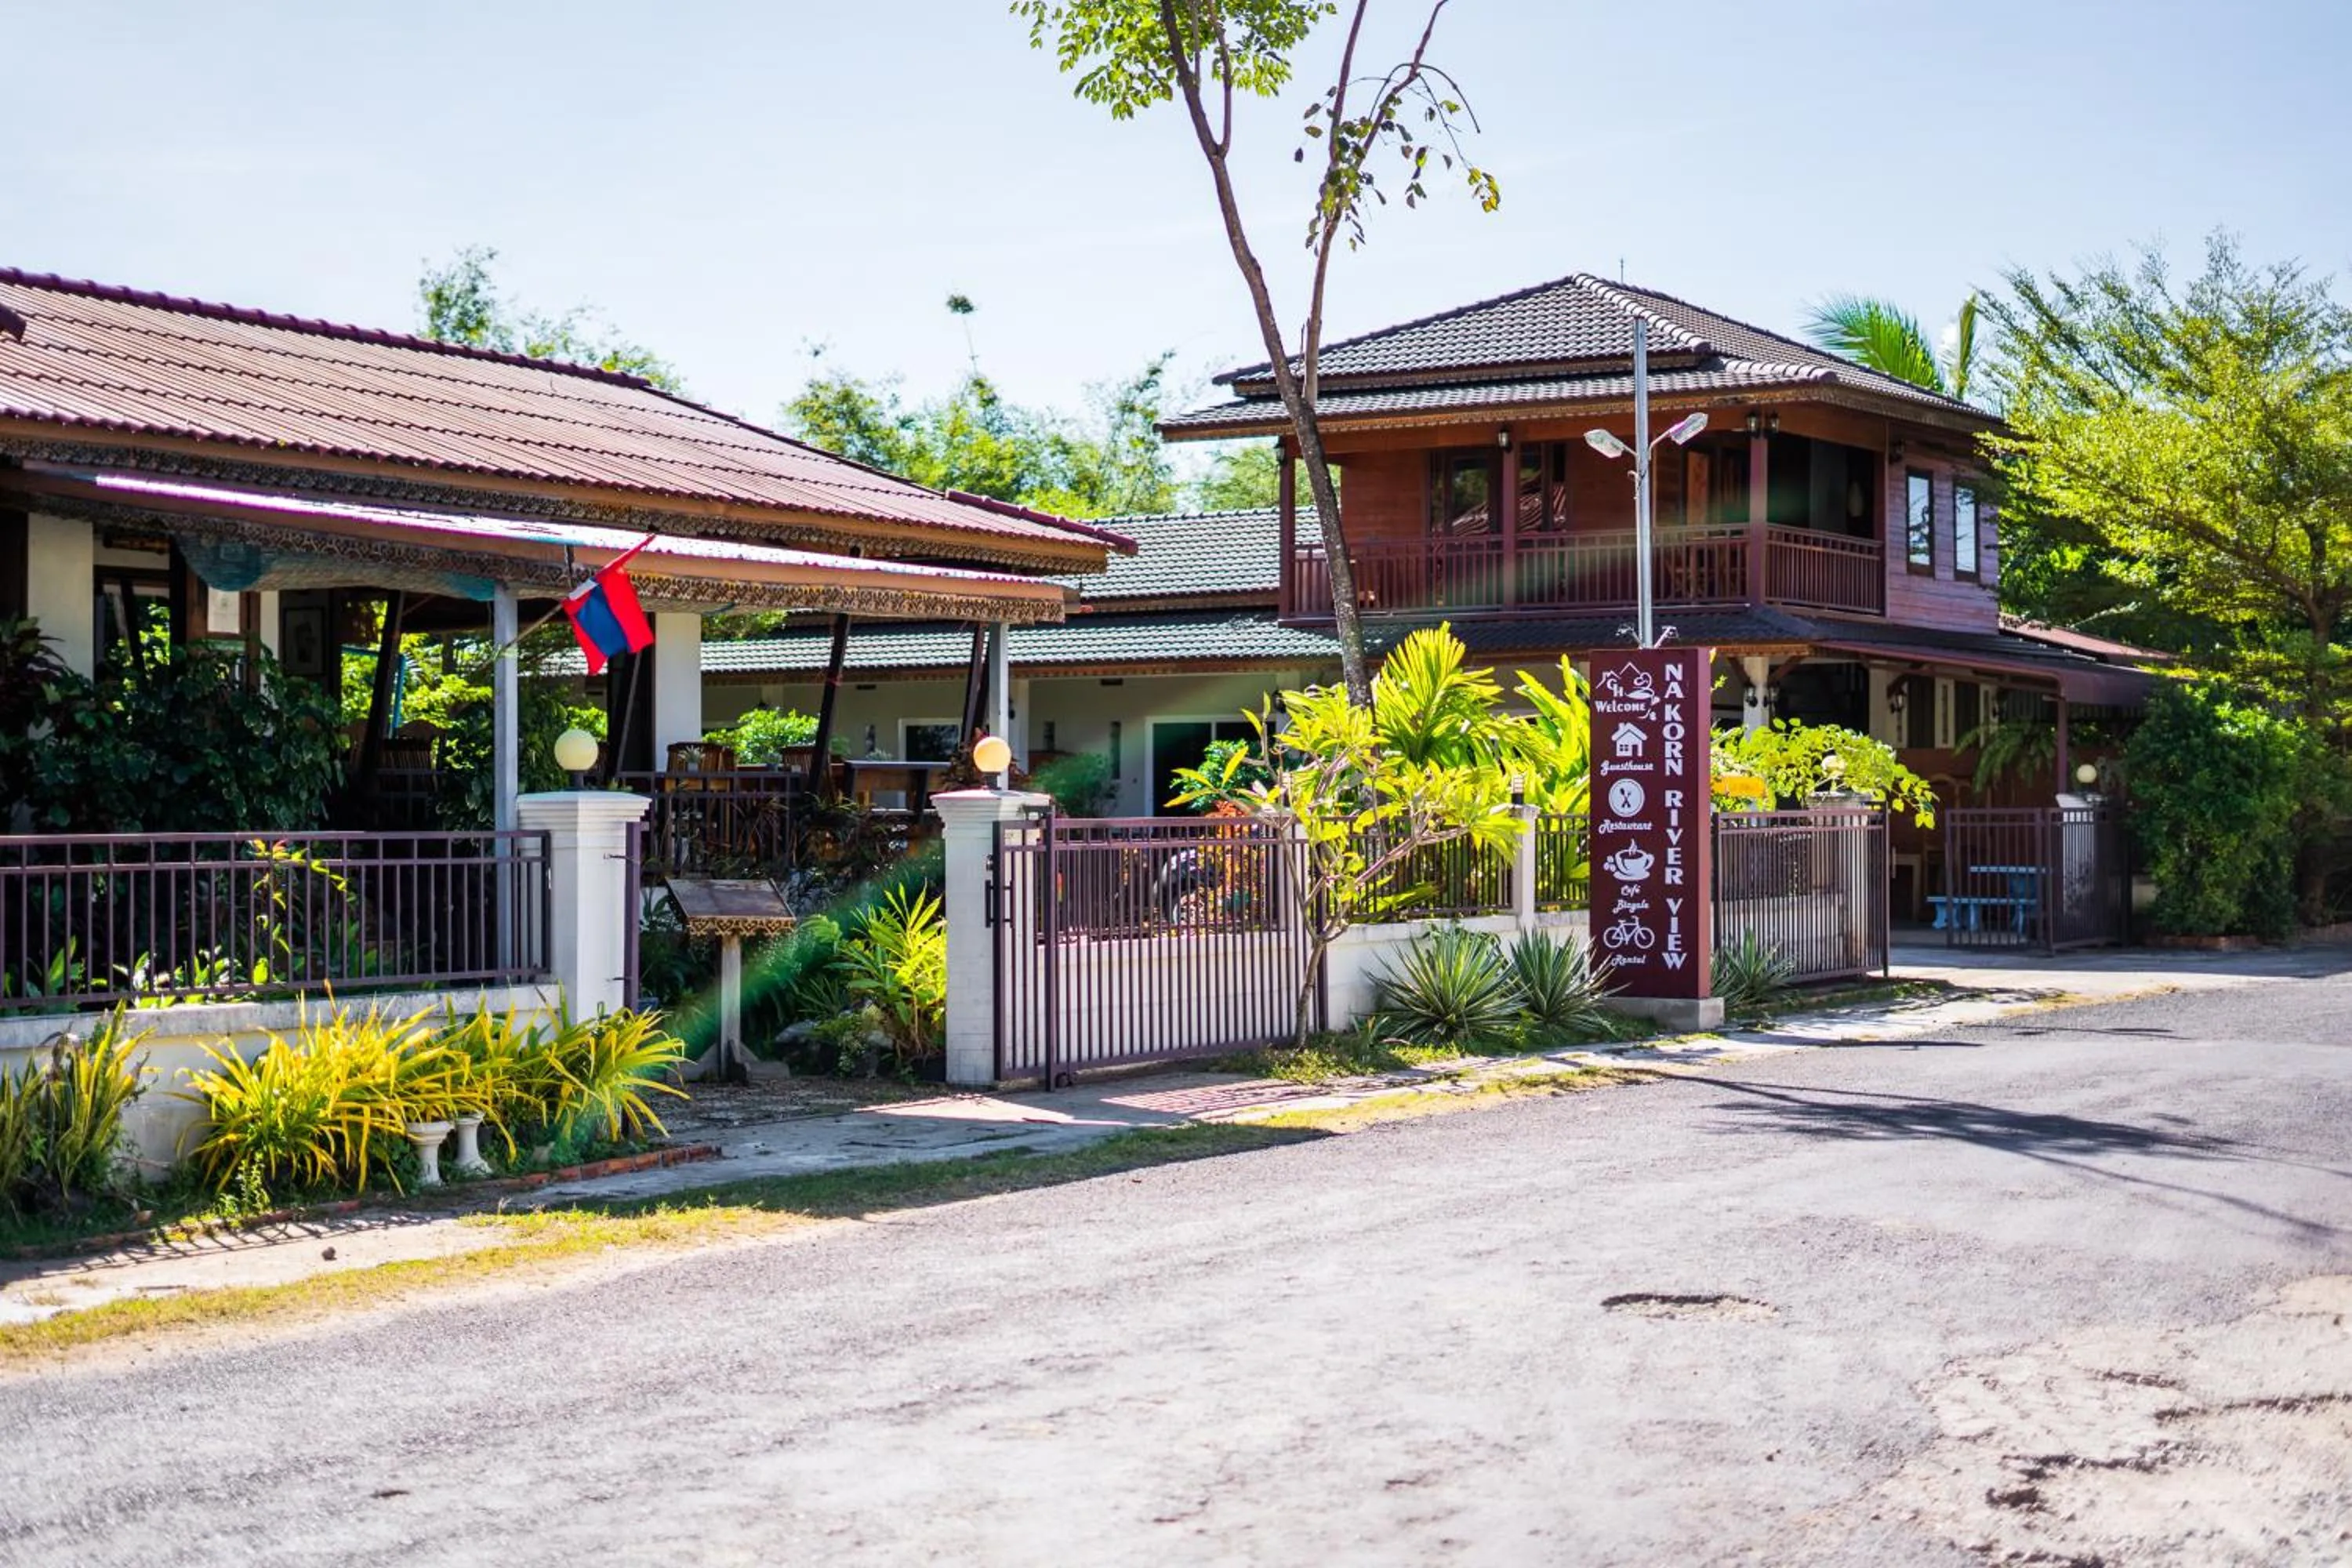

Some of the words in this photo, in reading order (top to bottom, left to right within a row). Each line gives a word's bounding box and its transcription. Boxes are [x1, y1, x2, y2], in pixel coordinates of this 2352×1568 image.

[1662, 664, 1685, 776] NAKORN
[1600, 760, 1654, 777] Guesthouse
[1599, 819, 1653, 834] Restaurant
[1664, 789, 1684, 885] RIVER
[1612, 899, 1650, 914] Bicycle
[1662, 898, 1687, 971] VIEW
[1611, 954, 1646, 967] Rental
